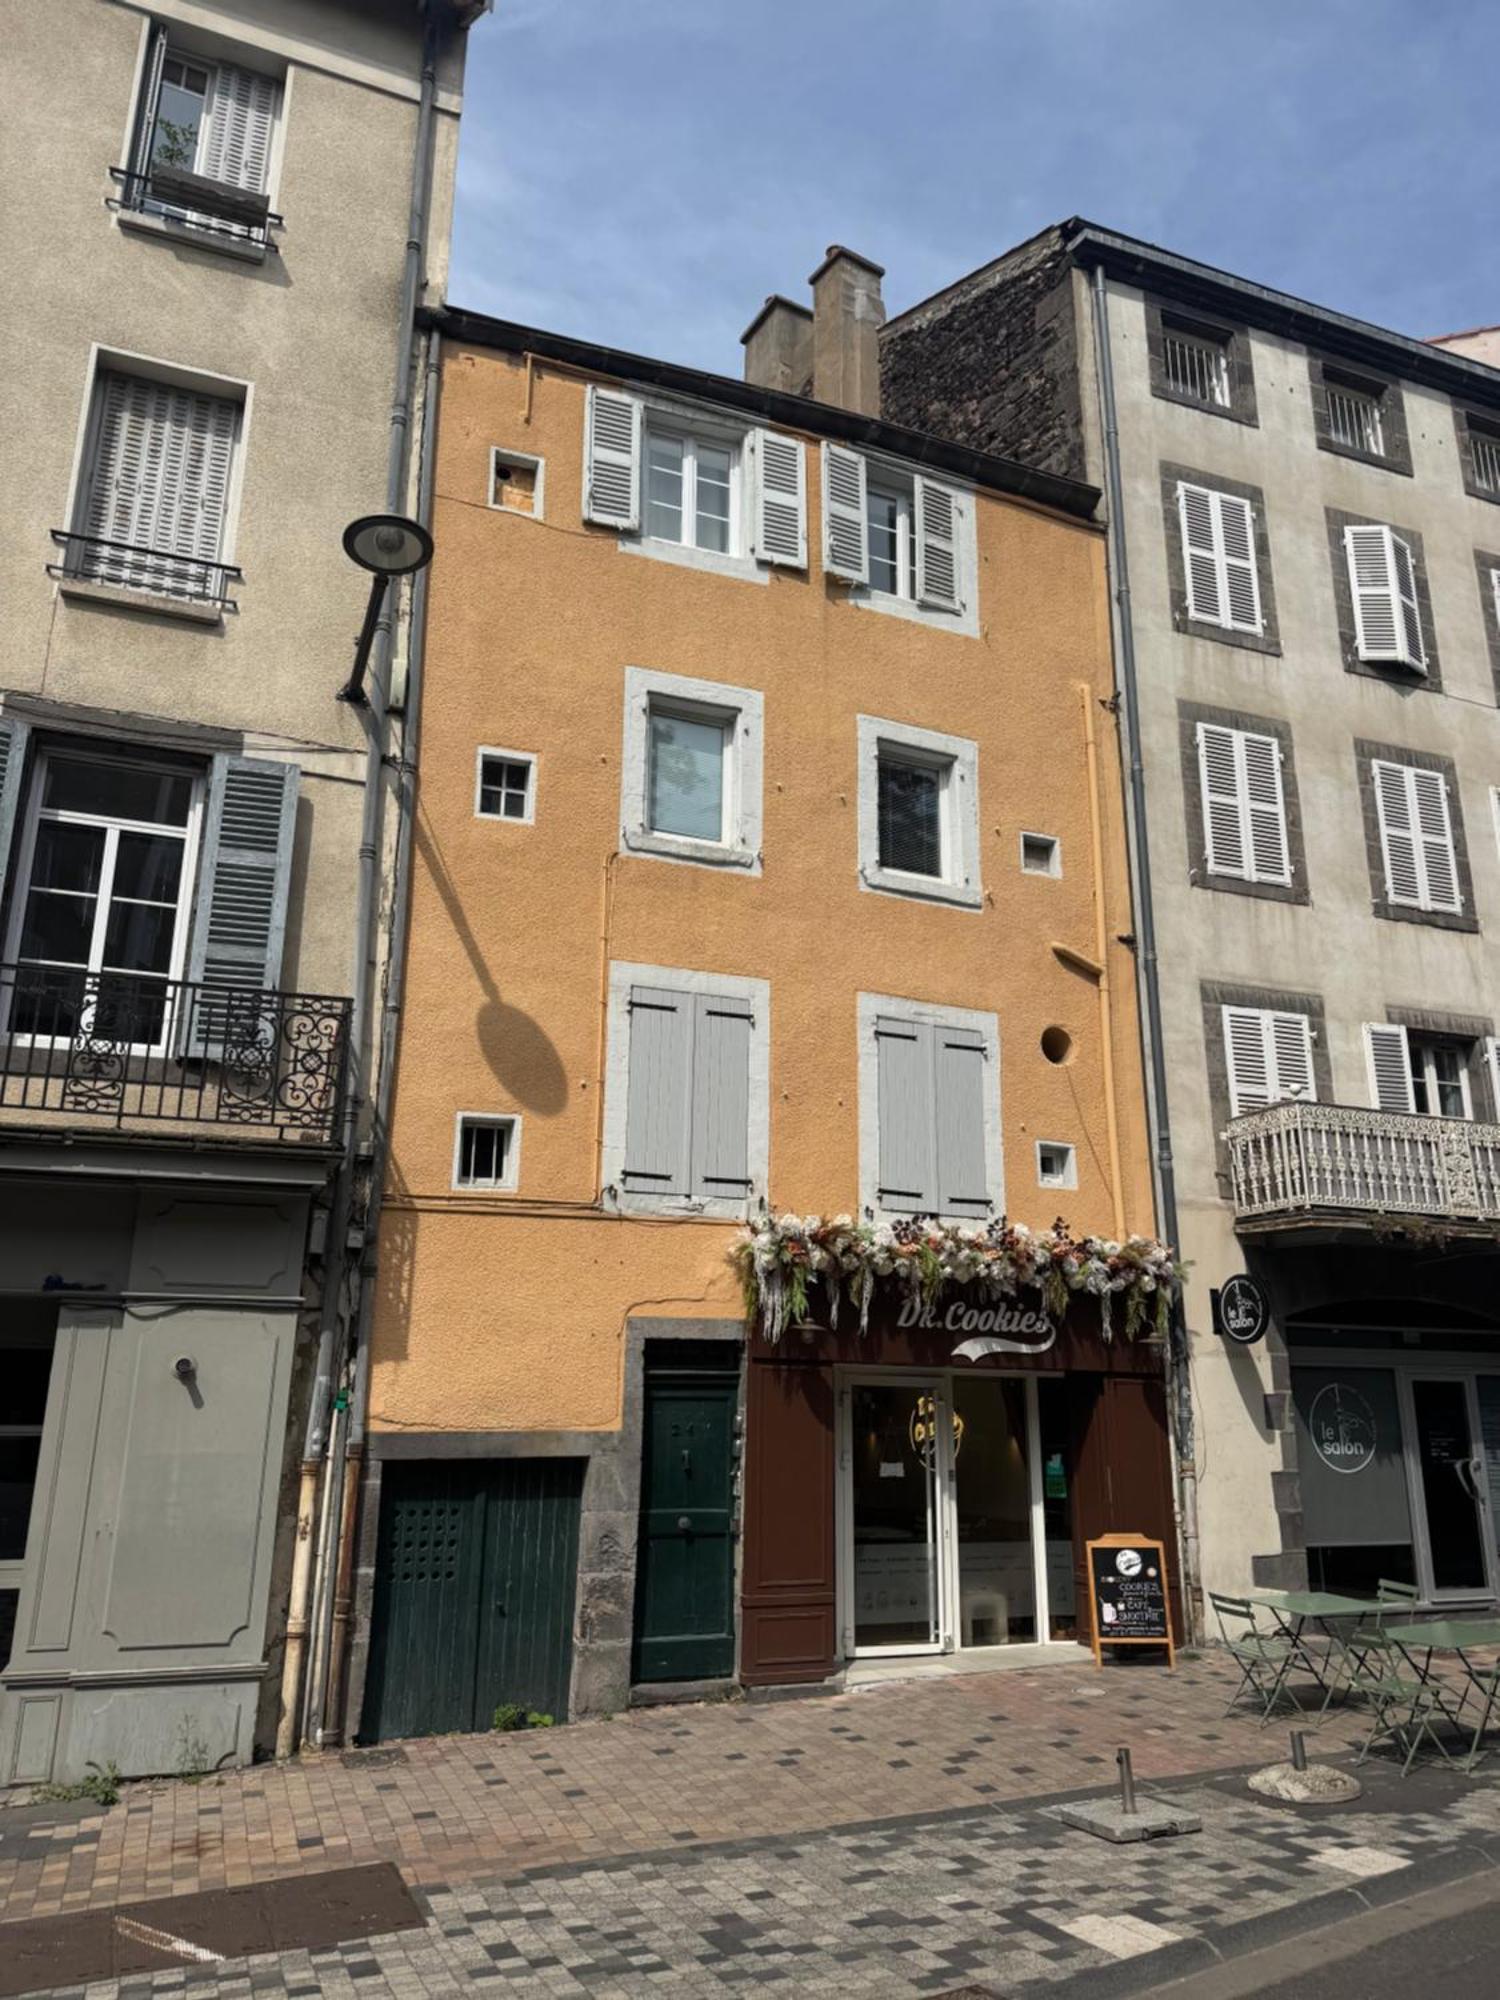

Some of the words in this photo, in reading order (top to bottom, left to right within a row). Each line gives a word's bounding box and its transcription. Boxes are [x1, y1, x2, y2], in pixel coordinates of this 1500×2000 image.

[944, 1301, 1053, 1333] Cookies
[1229, 1317, 1255, 1329] salon
[1321, 1421, 1335, 1440] le
[1323, 1440, 1364, 1456] salon
